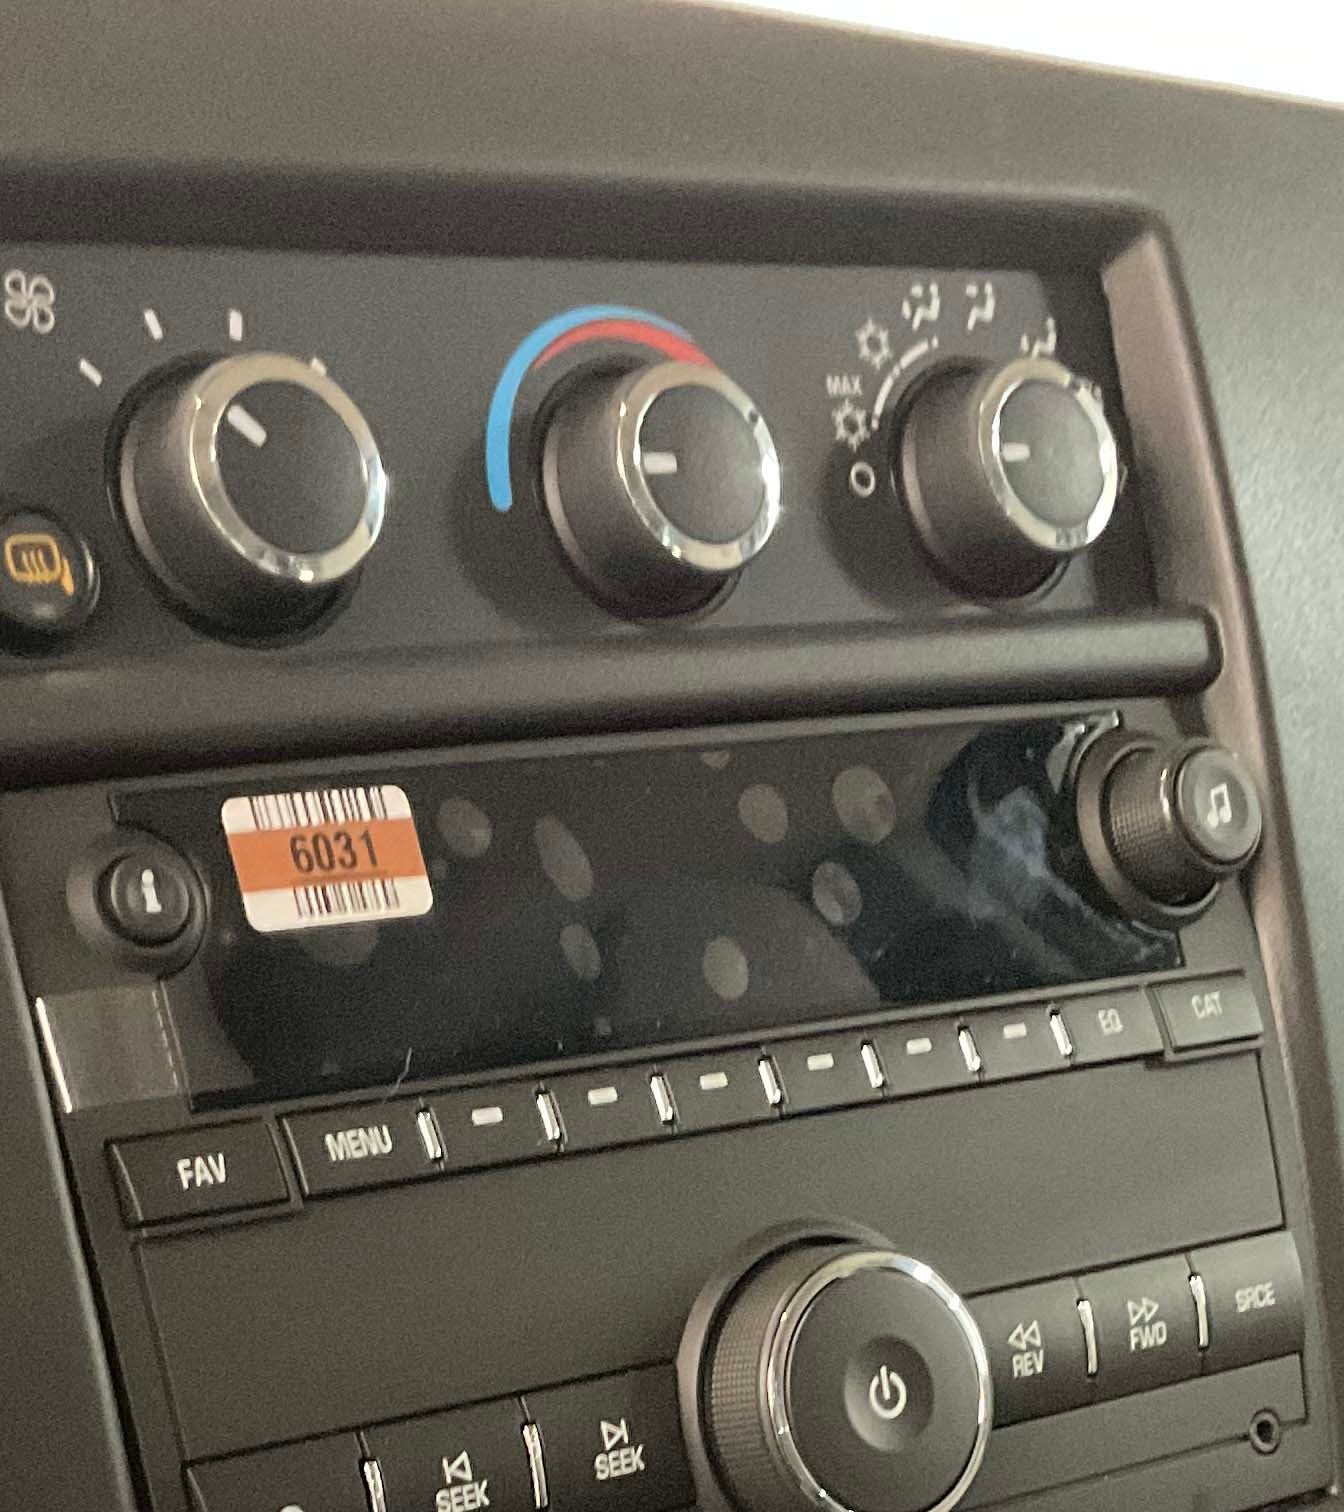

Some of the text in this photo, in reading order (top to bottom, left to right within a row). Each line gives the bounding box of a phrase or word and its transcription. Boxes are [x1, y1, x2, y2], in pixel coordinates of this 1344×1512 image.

[825, 374, 864, 397] MAX
[289, 829, 379, 874] 6031
[1191, 990, 1224, 1020] CAT
[1097, 1007, 1124, 1035] EQ
[324, 1124, 394, 1162] MENU
[176, 1152, 227, 1190] FAV
[1235, 1281, 1276, 1313] SRCE
[1130, 1320, 1167, 1351] FWD
[1012, 1349, 1045, 1379] REV
[595, 1443, 646, 1481] SEEK
